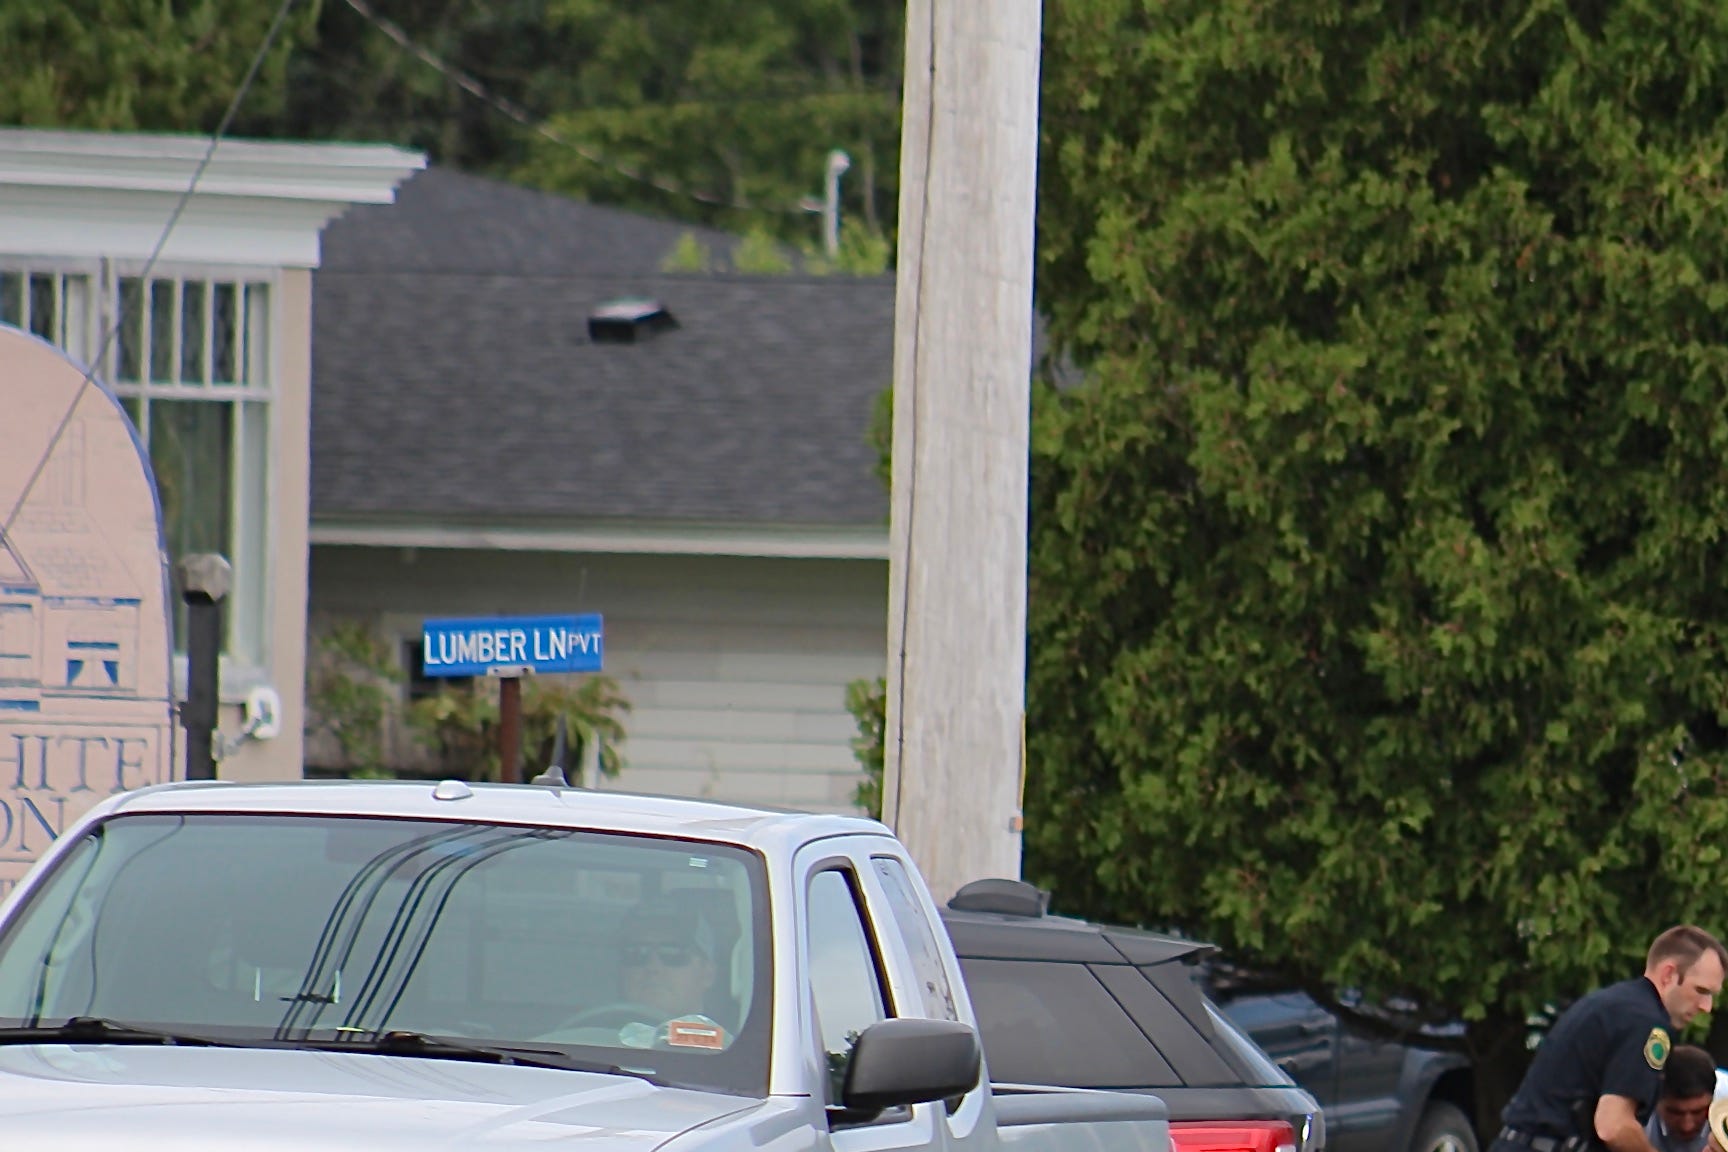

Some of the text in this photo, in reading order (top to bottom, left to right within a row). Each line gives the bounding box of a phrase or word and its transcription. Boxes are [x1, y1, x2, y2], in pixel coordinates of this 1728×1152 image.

[424, 627, 601, 664] LUMBER LN PVT
